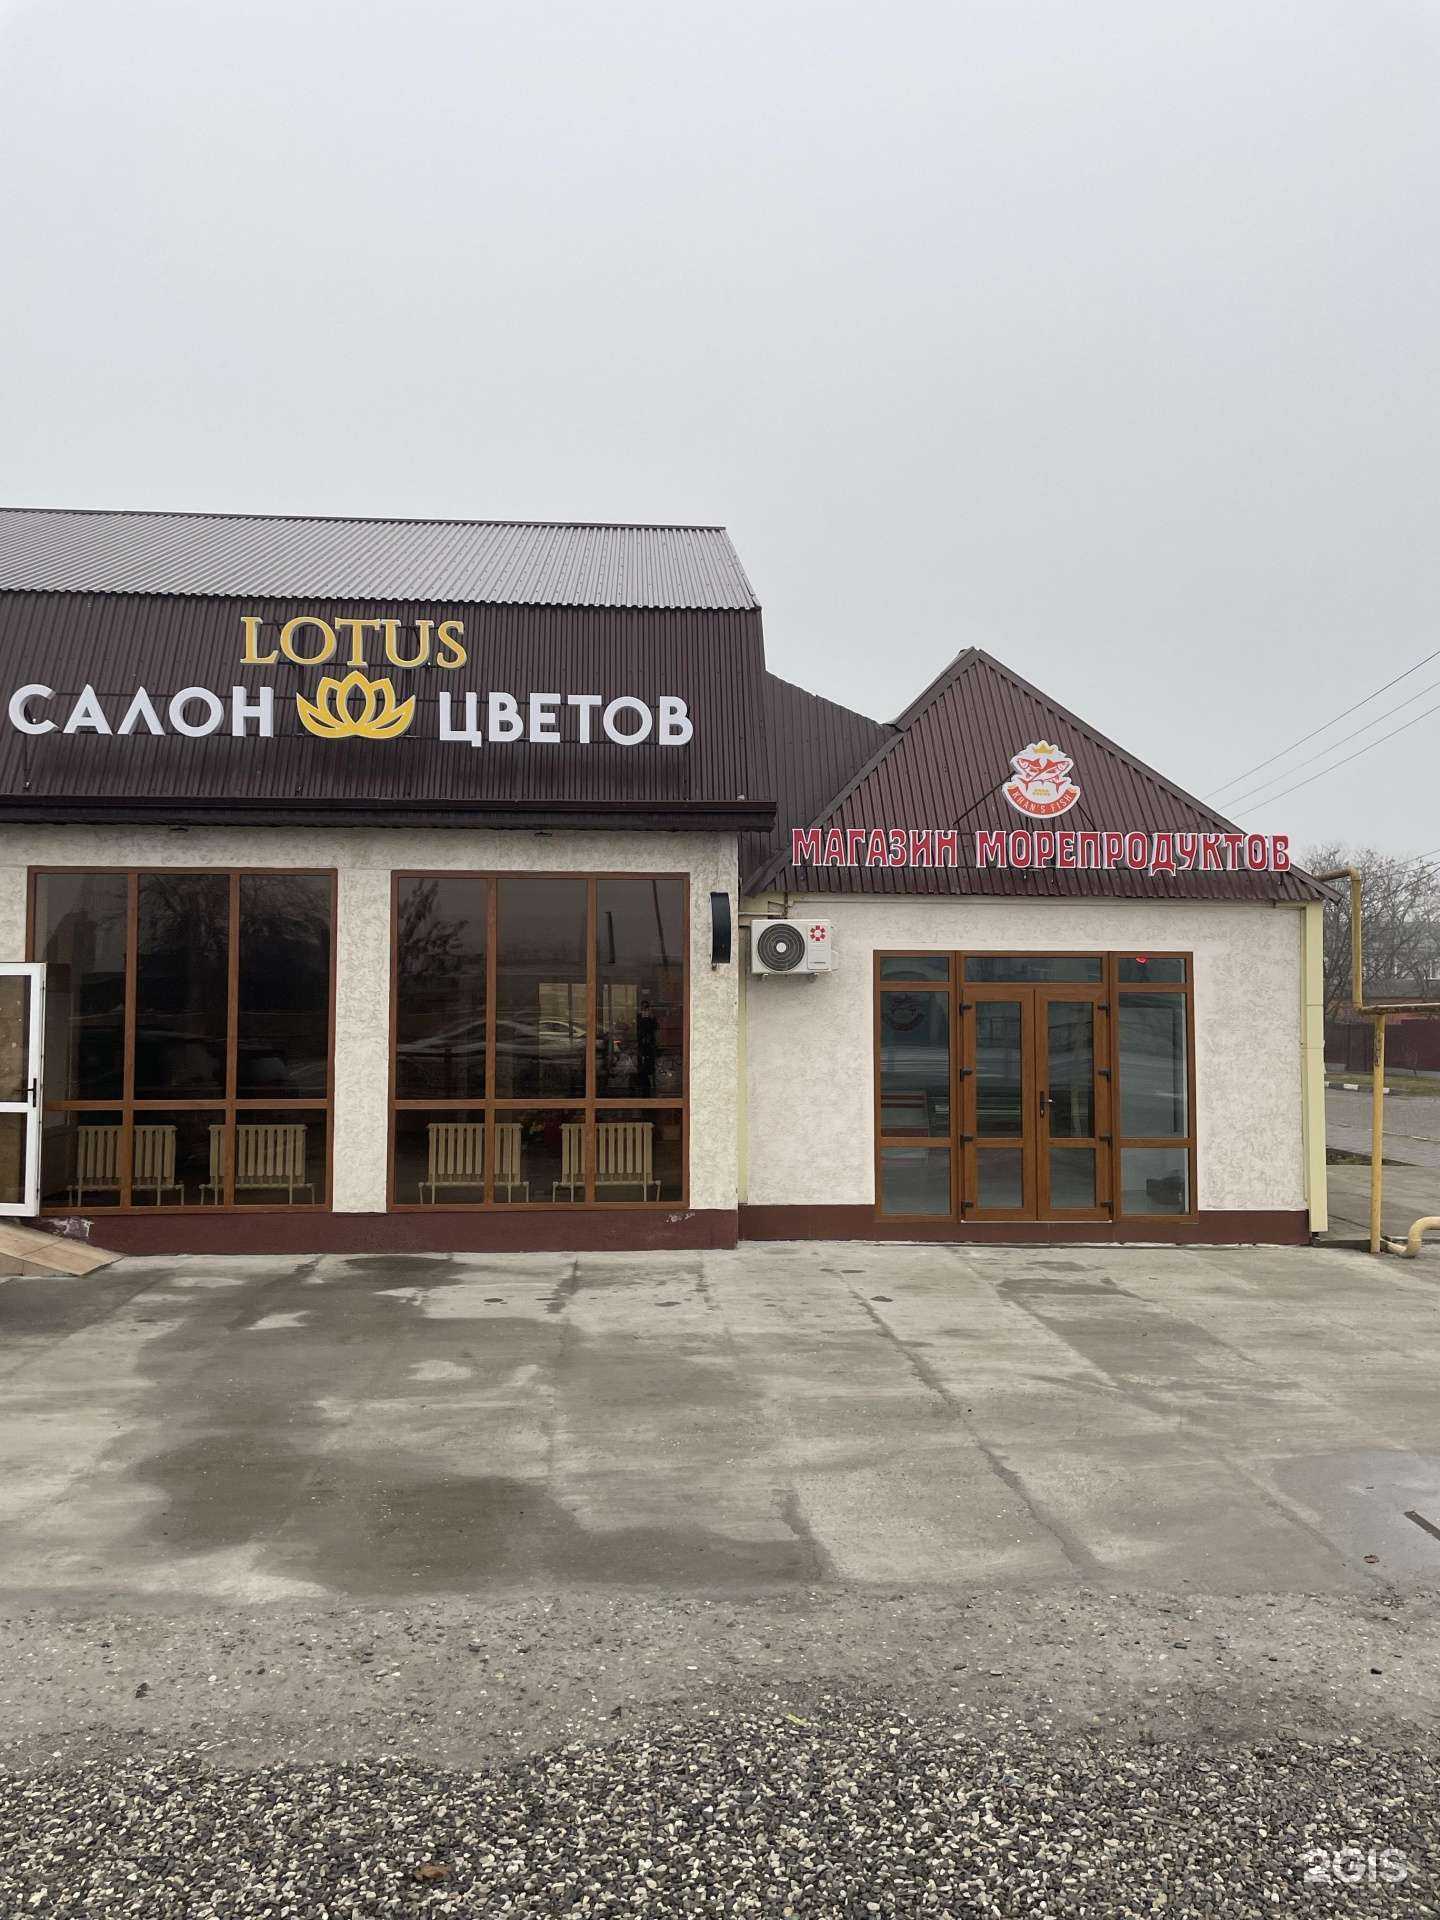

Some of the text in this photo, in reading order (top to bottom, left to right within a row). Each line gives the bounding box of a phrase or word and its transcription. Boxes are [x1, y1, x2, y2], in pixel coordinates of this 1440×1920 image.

[240, 616, 468, 669] LOTUS
[8, 683, 693, 747] САЛОН ЦВЕТОВ
[1051, 793, 1073, 812] FISH
[791, 827, 1291, 876] МАГАЗИН МОРЕПРОДУКТОВ
